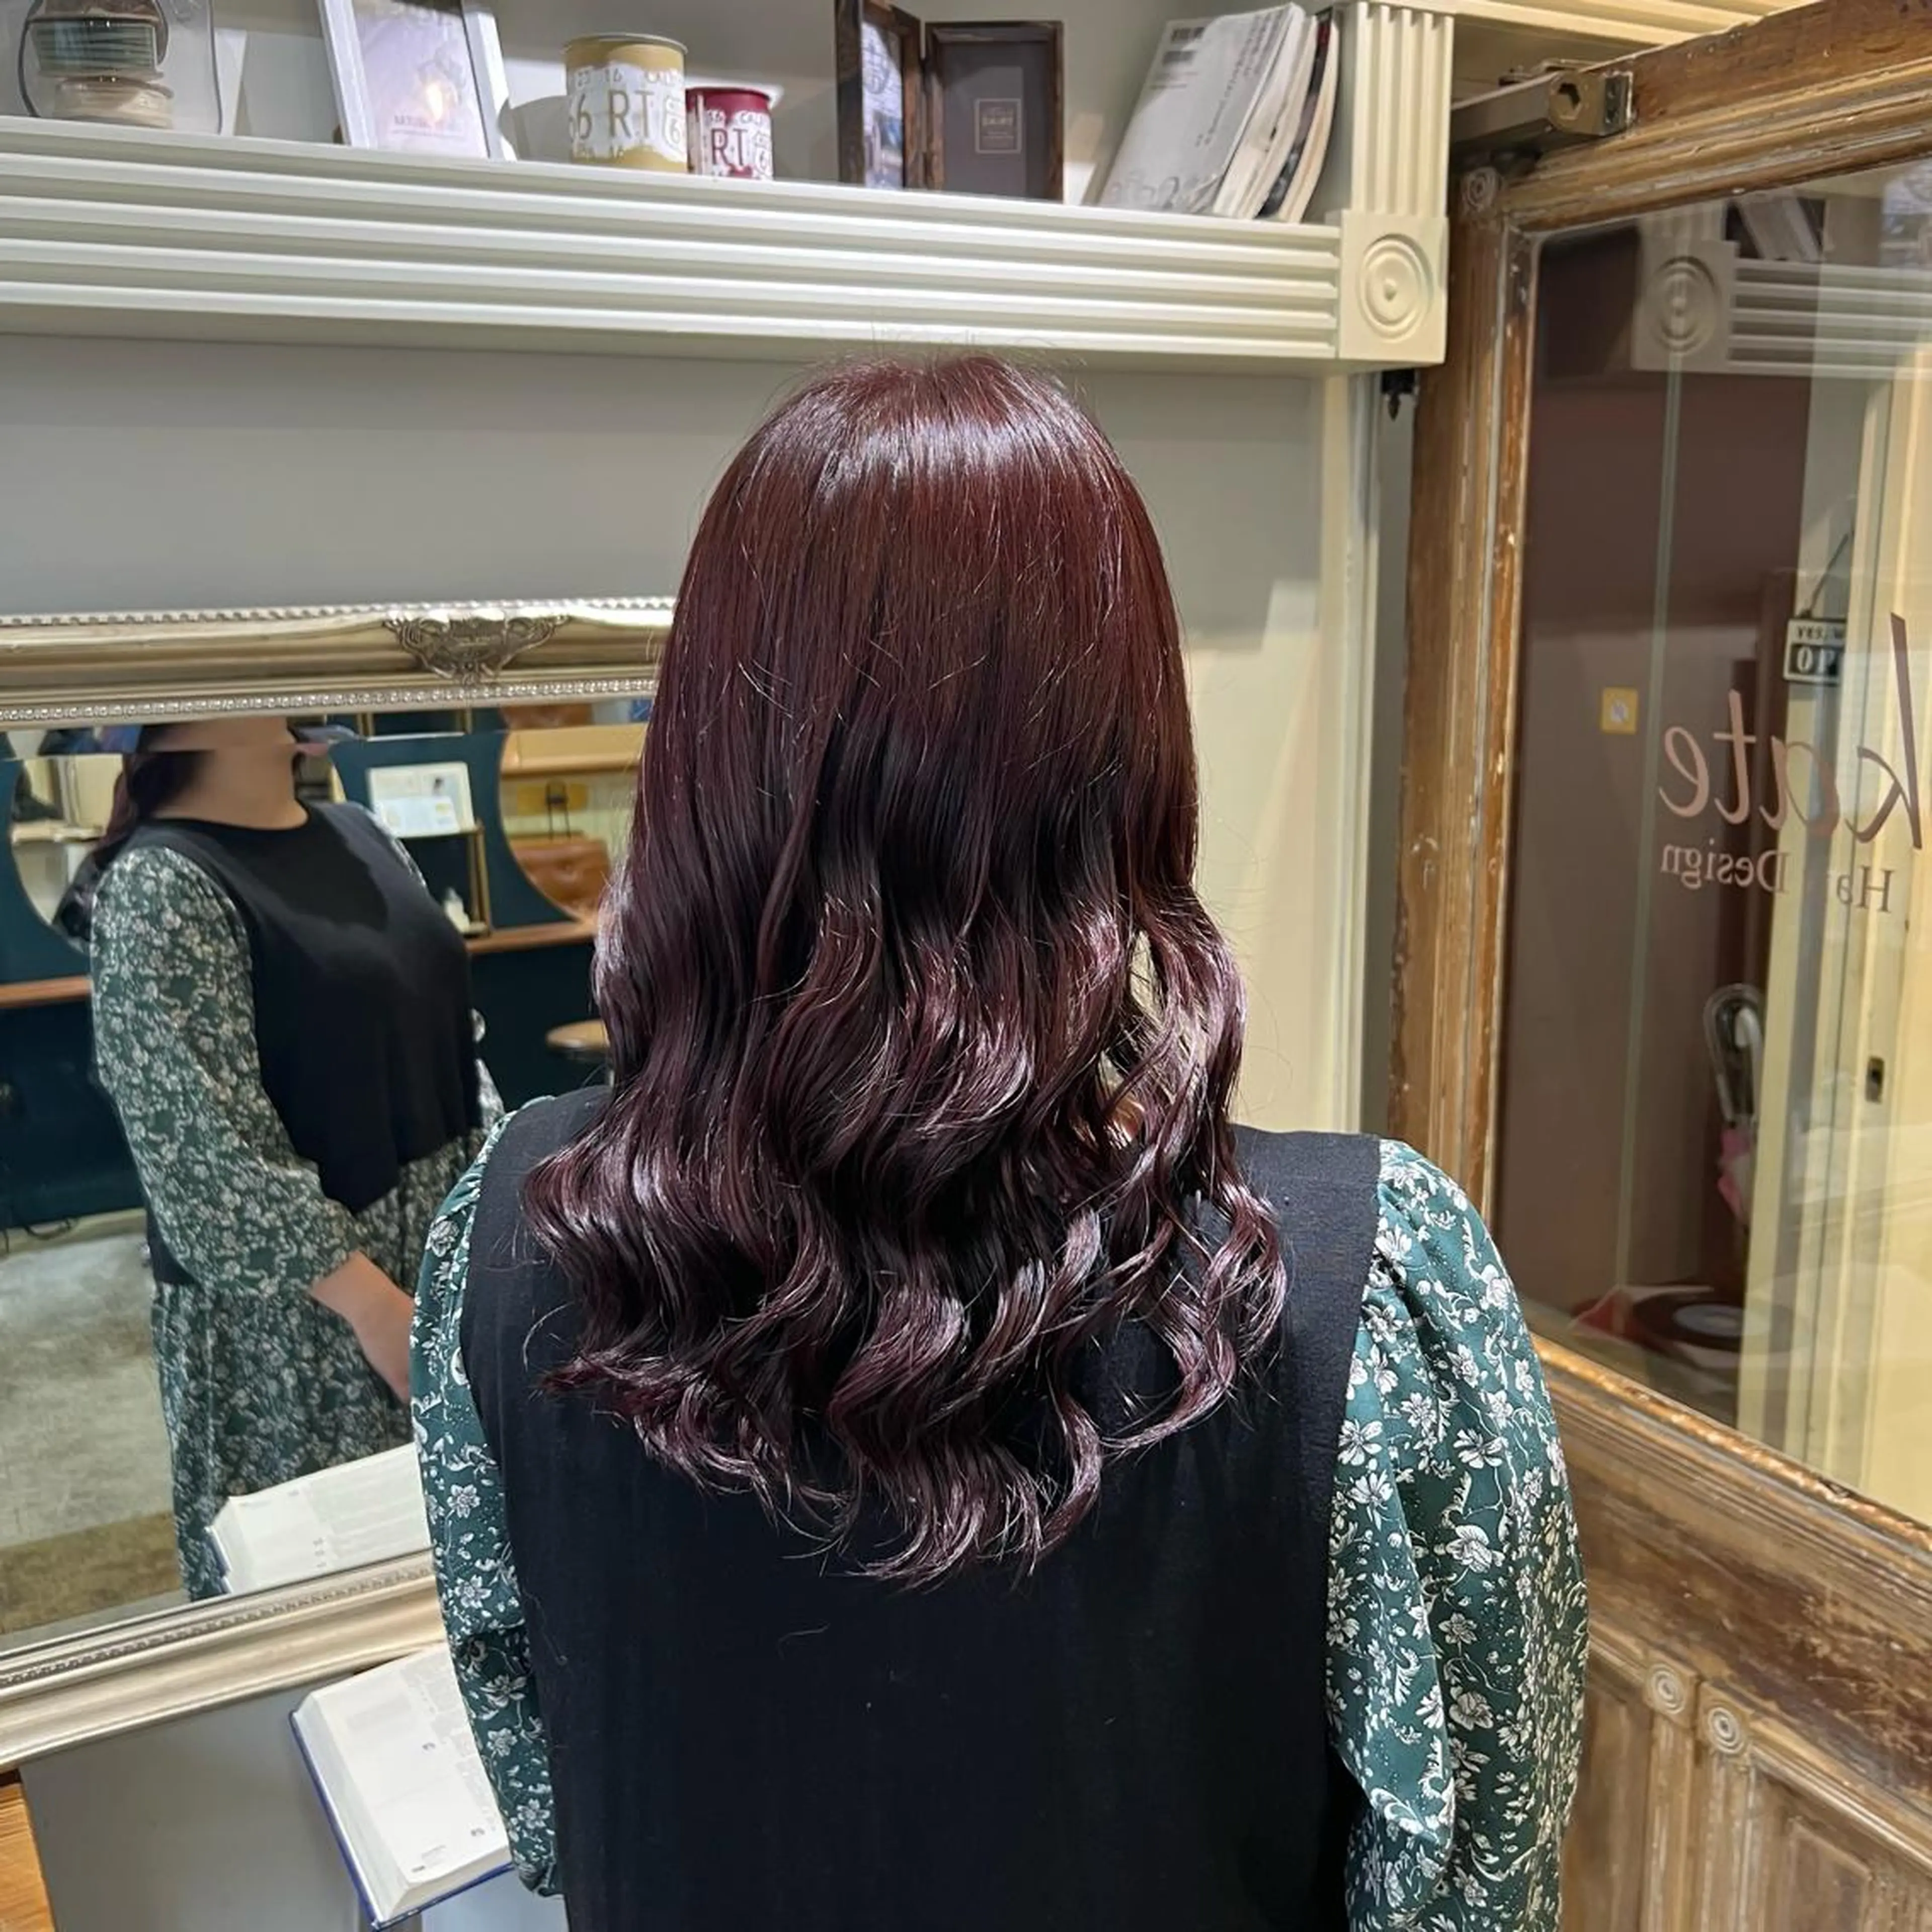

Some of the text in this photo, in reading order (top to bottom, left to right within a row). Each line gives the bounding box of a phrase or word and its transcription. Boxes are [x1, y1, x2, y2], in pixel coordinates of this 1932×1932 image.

[608, 89, 655, 139] RT
[711, 128, 748, 166] RT
[1797, 646, 1836, 673] OP
